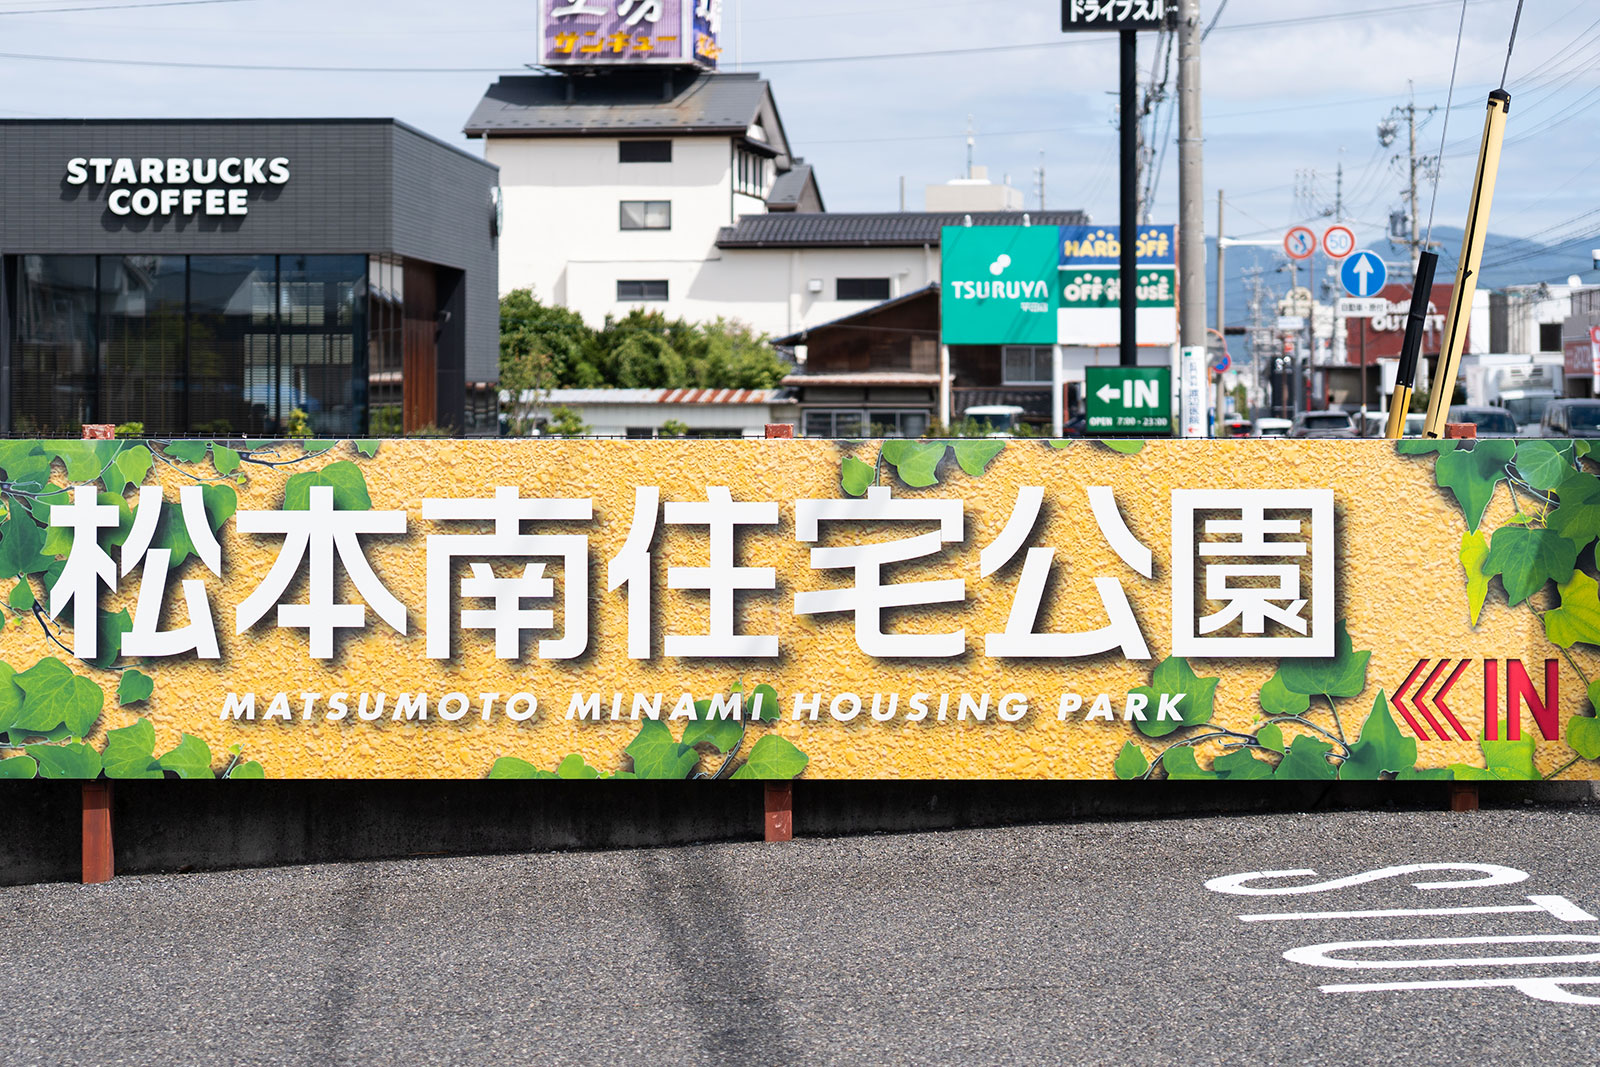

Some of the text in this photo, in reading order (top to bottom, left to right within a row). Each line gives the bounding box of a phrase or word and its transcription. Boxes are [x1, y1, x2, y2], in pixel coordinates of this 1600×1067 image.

[554, 31, 678, 54] サンキュー
[66, 157, 291, 186] STARBUCKS
[107, 188, 249, 216] COFFEE
[1064, 239, 1120, 258] HARD
[1328, 235, 1349, 250] 50
[951, 281, 1049, 300] TSURUYA
[1063, 283, 1170, 302] OFF HUSE
[1122, 379, 1159, 408] IN
[1088, 416, 1113, 426] OPEN
[50, 486, 1335, 660] 松本南住宅公園
[219, 692, 1187, 723] MATSUMOTO MINAMI HOUSING PARK
[1484, 658, 1560, 741] IN
